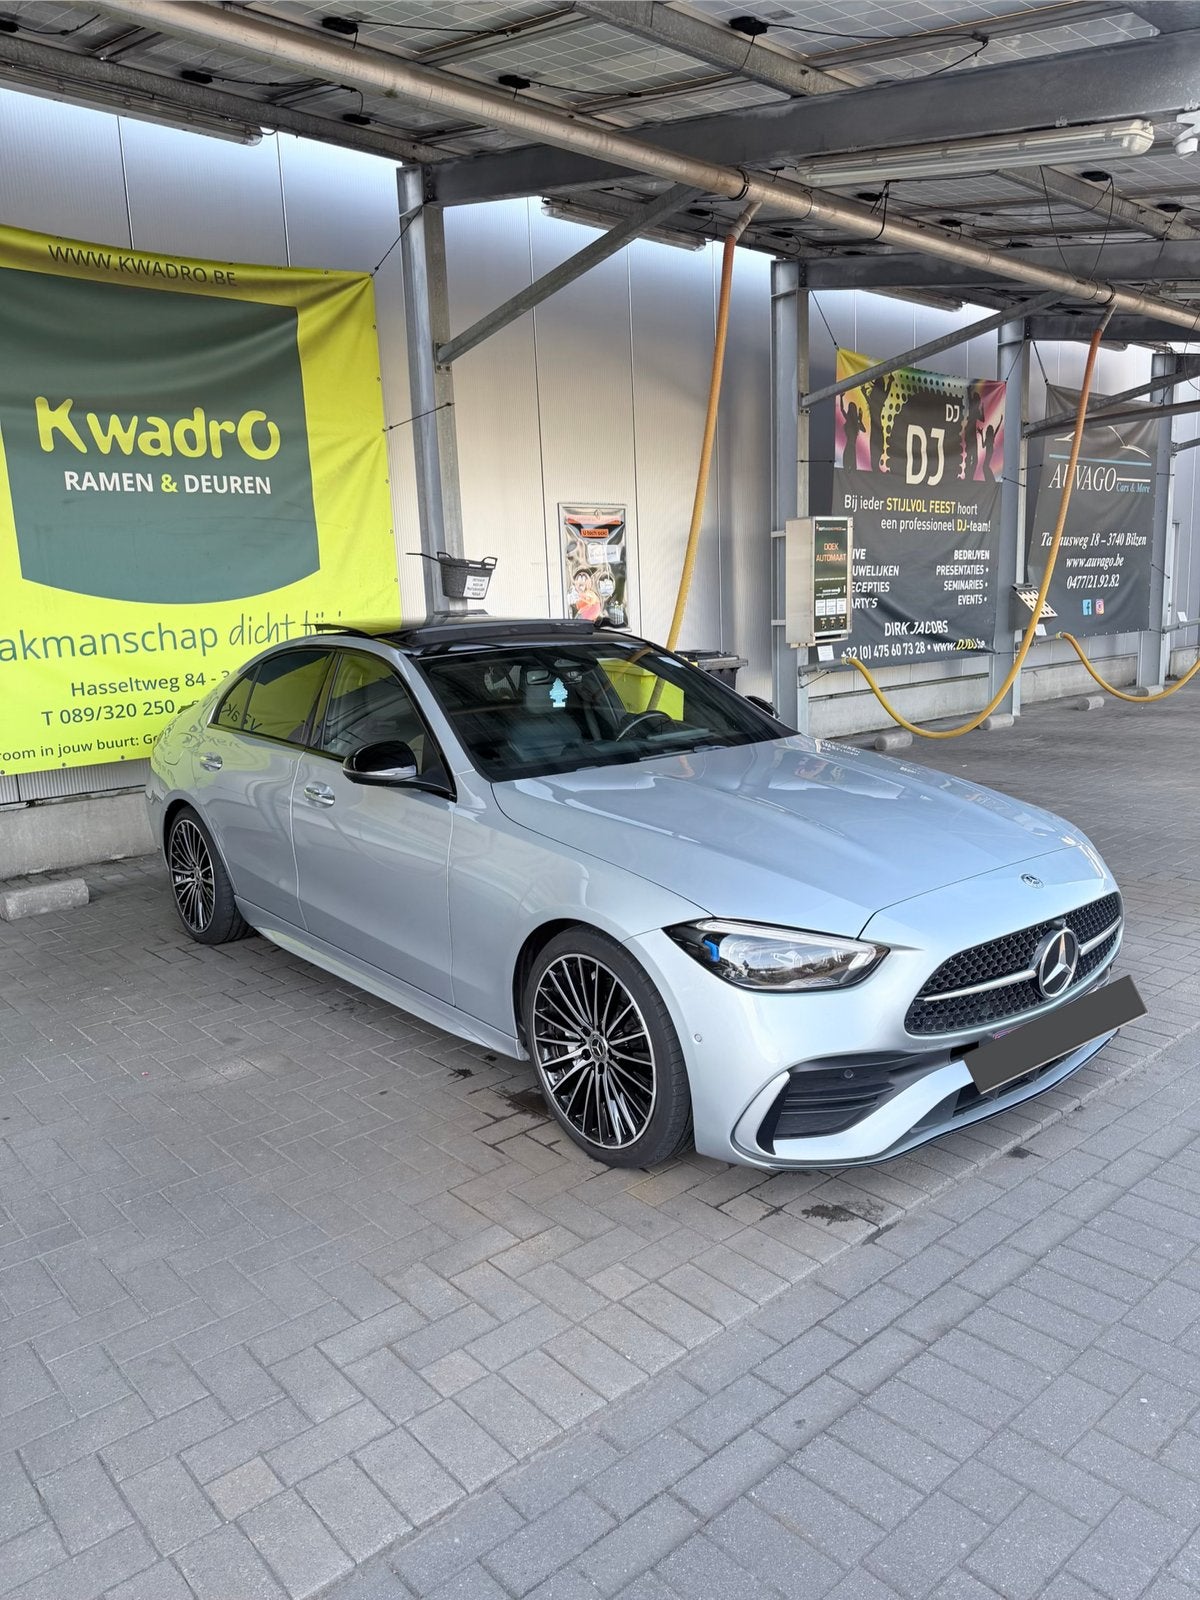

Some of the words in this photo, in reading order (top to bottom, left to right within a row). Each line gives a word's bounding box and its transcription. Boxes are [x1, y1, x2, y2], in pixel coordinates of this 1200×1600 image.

[48, 244, 238, 287] WWW.KWADRO.BE
[945, 404, 960, 423] DJ
[905, 424, 945, 486] DJ
[64, 471, 154, 492] RAMEN
[161, 473, 178, 493] &
[184, 474, 271, 494] DEUREN
[1116, 481, 1129, 492] Cars
[844, 494, 858, 512] Bij
[860, 496, 884, 510] ieder
[886, 497, 927, 513] STIJLVOL
[929, 500, 956, 514] FEEST
[957, 502, 978, 515] hoort
[881, 518, 897, 530] een
[899, 517, 955, 533] professioneel
[957, 519, 991, 532] DJ-team!
[1041, 532, 1089, 550] Tanusweg
[1089, 532, 1100, 547] 18
[1107, 532, 1125, 546] 3740
[1125, 532, 1147, 547] Bilzen
[852, 548, 866, 560] IVE
[953, 549, 990, 560] BEDRIJVEN
[1066, 553, 1124, 570] www.auvago.be
[852, 565, 900, 577] UWELIJKEN
[936, 564, 984, 576] PRESENTATIES
[851, 581, 890, 593] ECEPTIES
[943, 579, 984, 591] SEMINARIES
[851, 597, 879, 609] RTY'S
[958, 594, 983, 605] EVENTS
[229, 612, 295, 646] dicht
[884, 621, 910, 636] DIRK
[910, 620, 949, 635] JACOBS
[859, 645, 872, 660] (0)
[873, 644, 890, 658] 475
[891, 642, 901, 656] 60
[902, 642, 914, 656] 73
[915, 641, 926, 654] 28
[71, 677, 180, 697] Hasseltweg
[185, 672, 206, 688] 84
[41, 710, 53, 726] T
[60, 702, 137, 724] 089/320
[143, 699, 175, 716] 250
[0, 749, 36, 761] oom
[40, 746, 54, 757] in
[58, 742, 93, 758] jouw
[97, 736, 139, 750] buurt:
